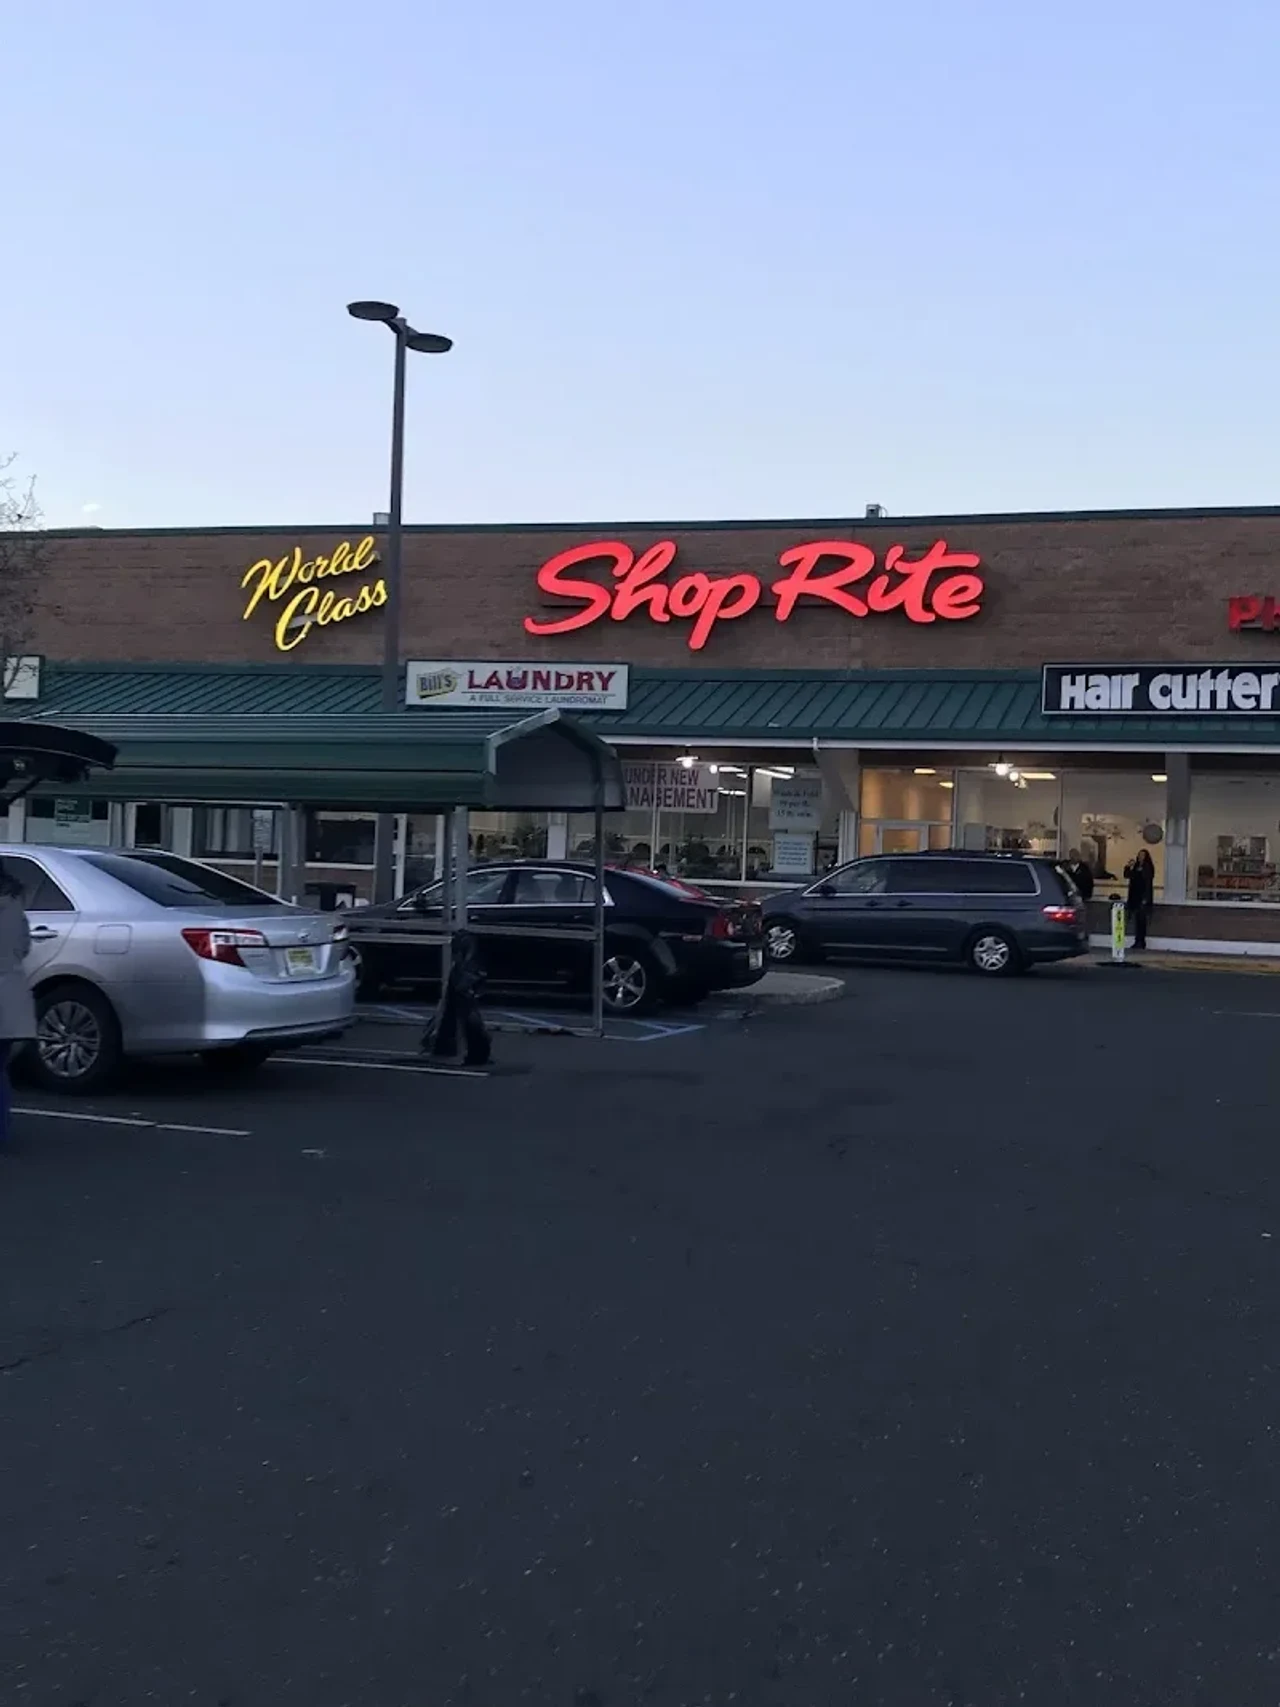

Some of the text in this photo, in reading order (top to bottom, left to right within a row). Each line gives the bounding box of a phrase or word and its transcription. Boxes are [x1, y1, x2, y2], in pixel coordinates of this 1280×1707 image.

[240, 536, 375, 620] World
[275, 579, 388, 650] Class
[419, 673, 453, 691] Bill's
[467, 669, 617, 692] LAUNDRY
[1060, 672, 1140, 710] Hair
[469, 694, 608, 705] A FULL SERVICE LAUNDROMAT
[624, 767, 699, 786] UNDER NEW
[626, 787, 717, 809] NAGEMENT
